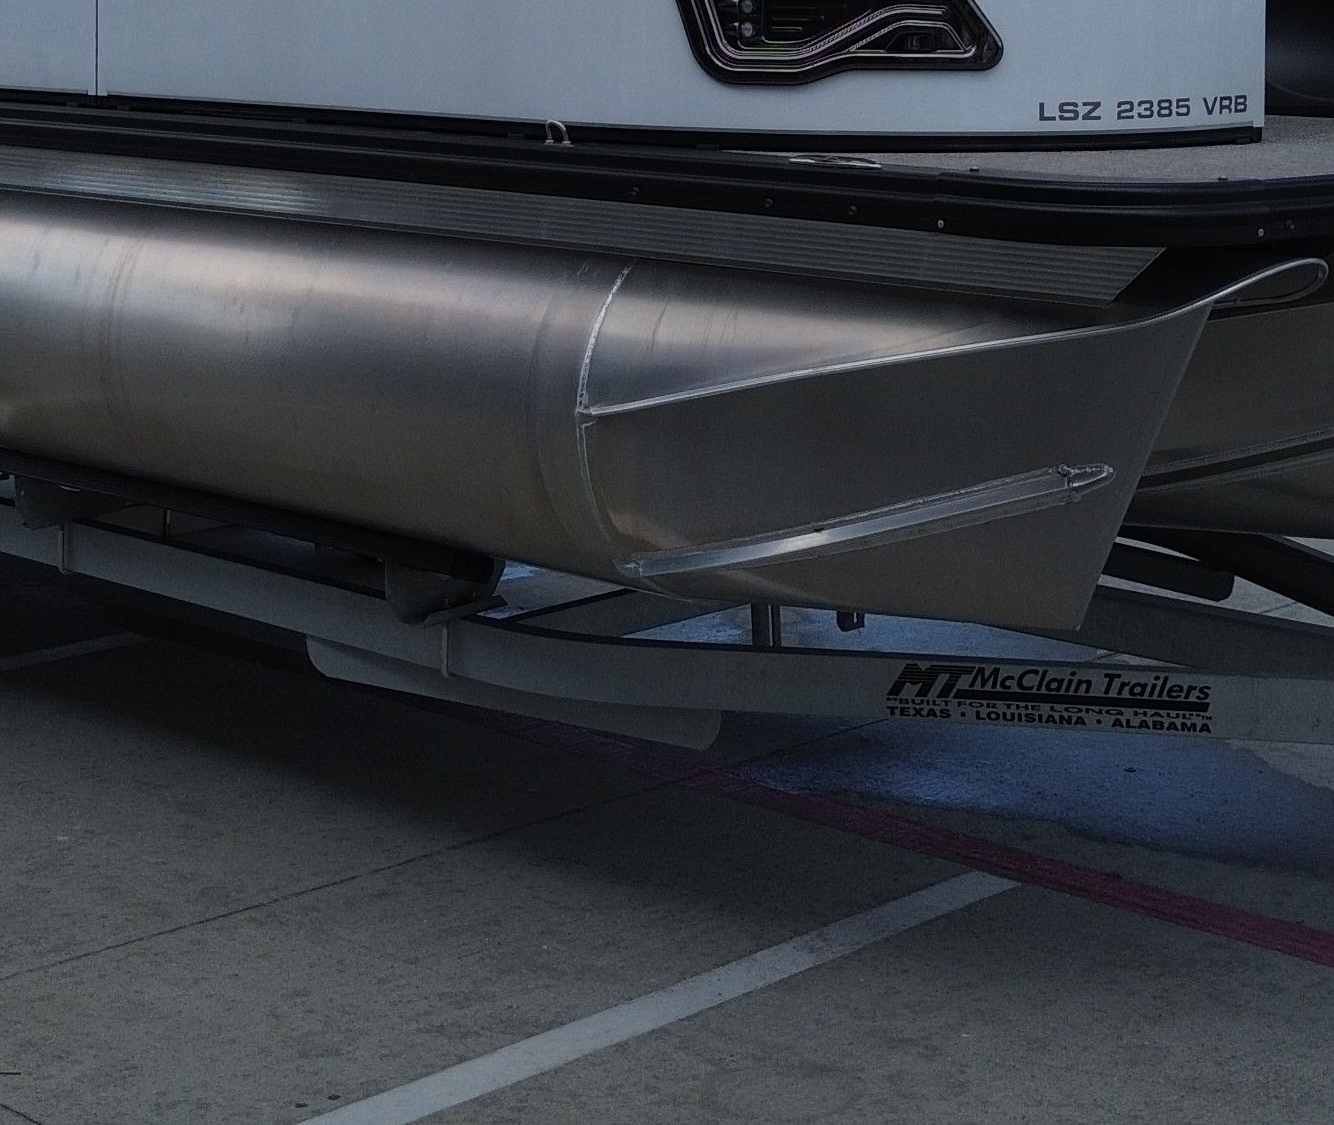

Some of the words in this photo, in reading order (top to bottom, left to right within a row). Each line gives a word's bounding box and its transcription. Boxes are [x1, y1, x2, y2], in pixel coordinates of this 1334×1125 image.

[1039, 101, 1102, 121] LSZ
[1117, 97, 1191, 120] 2385
[1202, 94, 1248, 116] VRB
[886, 663, 976, 698] MT
[969, 666, 1093, 694] McClain
[1104, 672, 1212, 700] Trailers
[886, 706, 952, 718] TEXAS
[975, 710, 1087, 726] LOUISIANA
[1111, 718, 1212, 733] ALABAMA
[956, 700, 998, 710] FOR
[1003, 703, 1041, 711] THE
[1049, 705, 1124, 716] LONG
